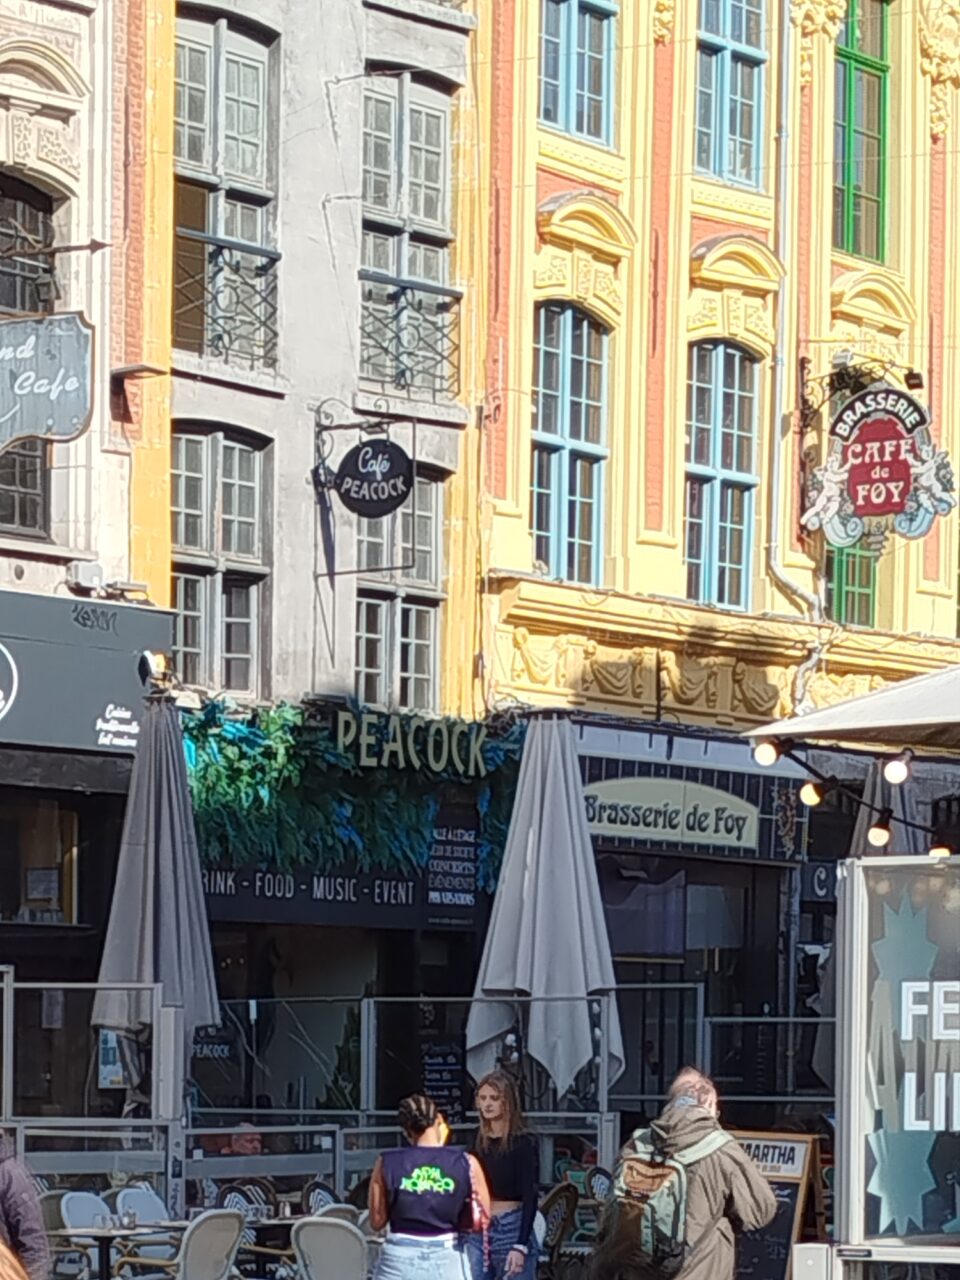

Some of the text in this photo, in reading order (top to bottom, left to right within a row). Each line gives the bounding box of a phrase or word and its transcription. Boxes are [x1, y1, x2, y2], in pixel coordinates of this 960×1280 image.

[14, 368, 79, 400] Cafe
[835, 393, 921, 437] BRASSERIE
[358, 447, 390, 480] Café
[871, 466, 890, 478] de
[340, 475, 407, 500] PEACOCK
[337, 710, 489, 779] PEACOCK
[584, 794, 749, 842] Brasserie de Foy
[201, 869, 235, 895] RINK
[255, 872, 294, 898] FOOD
[312, 876, 358, 902] MUSIC
[374, 879, 415, 905] EVENT
